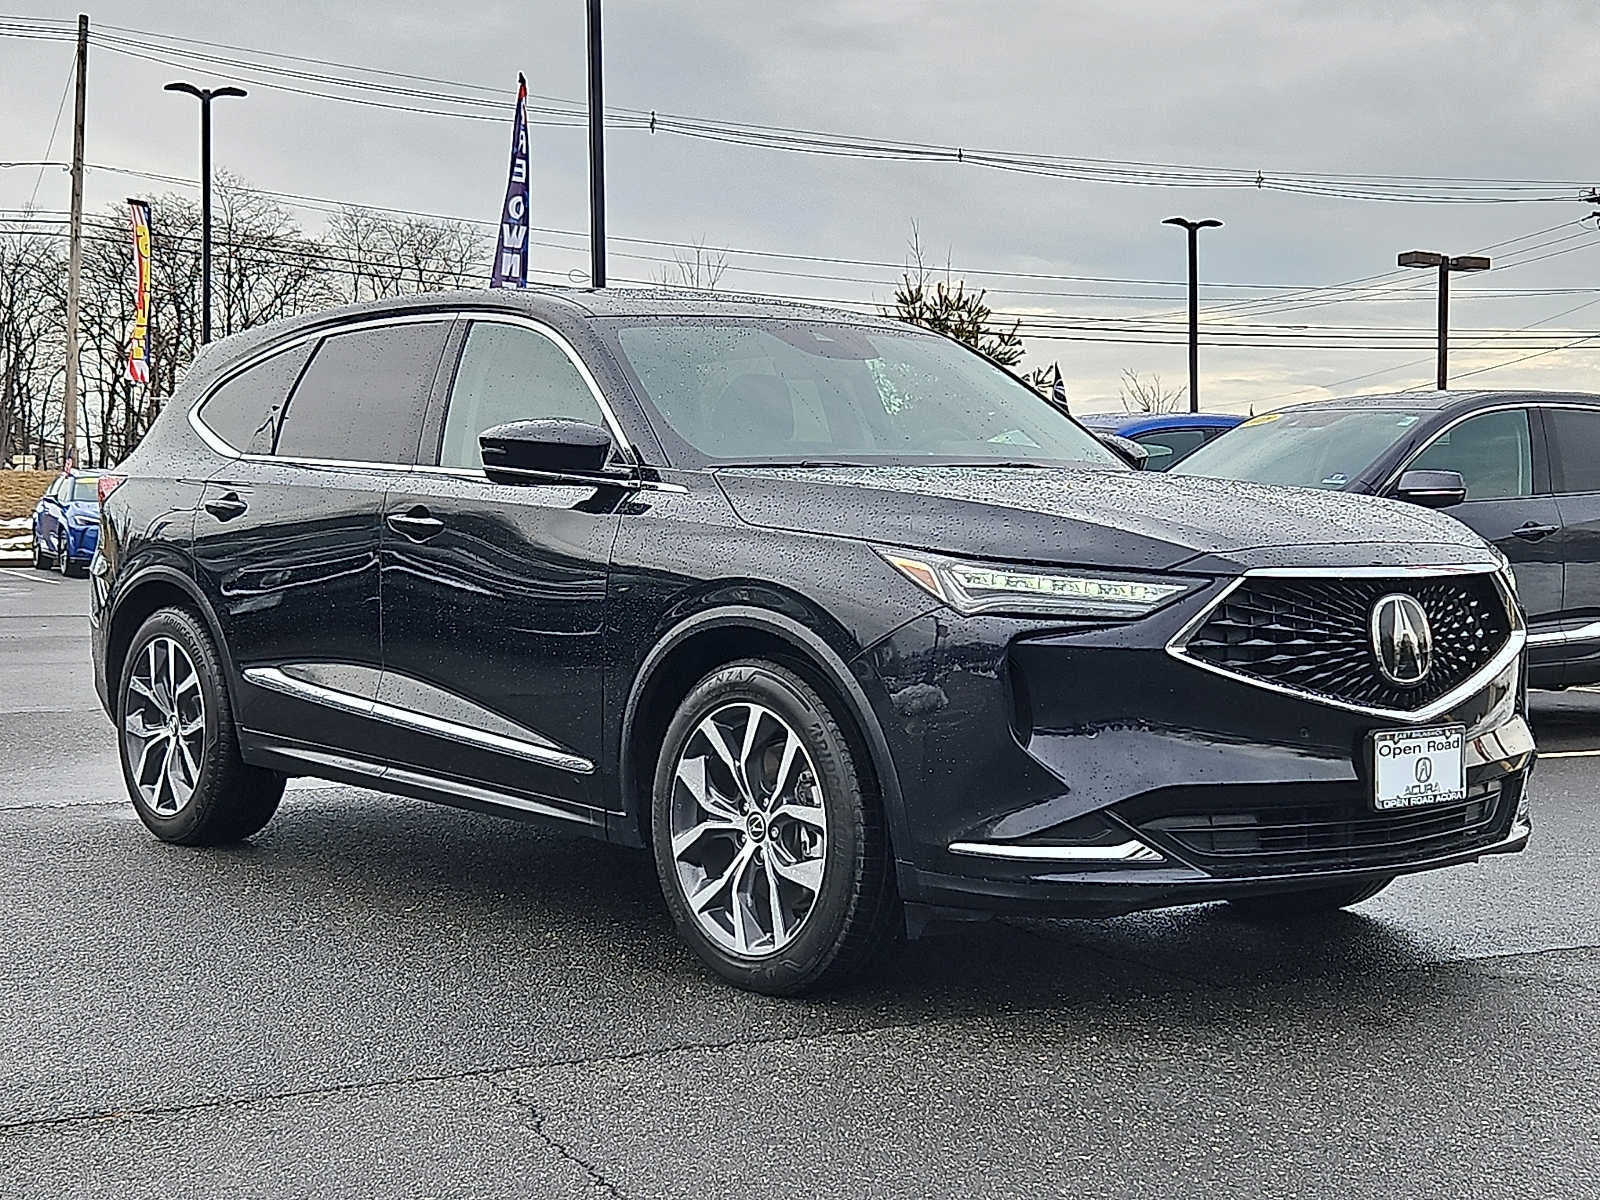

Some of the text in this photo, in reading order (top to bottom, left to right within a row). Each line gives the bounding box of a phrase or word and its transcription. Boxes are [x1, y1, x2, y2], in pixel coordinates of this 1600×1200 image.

[1379, 737, 1460, 759] Open Road
[1404, 782, 1440, 796] ACURA
[1383, 791, 1462, 808] OPEN ROAD ACURA
